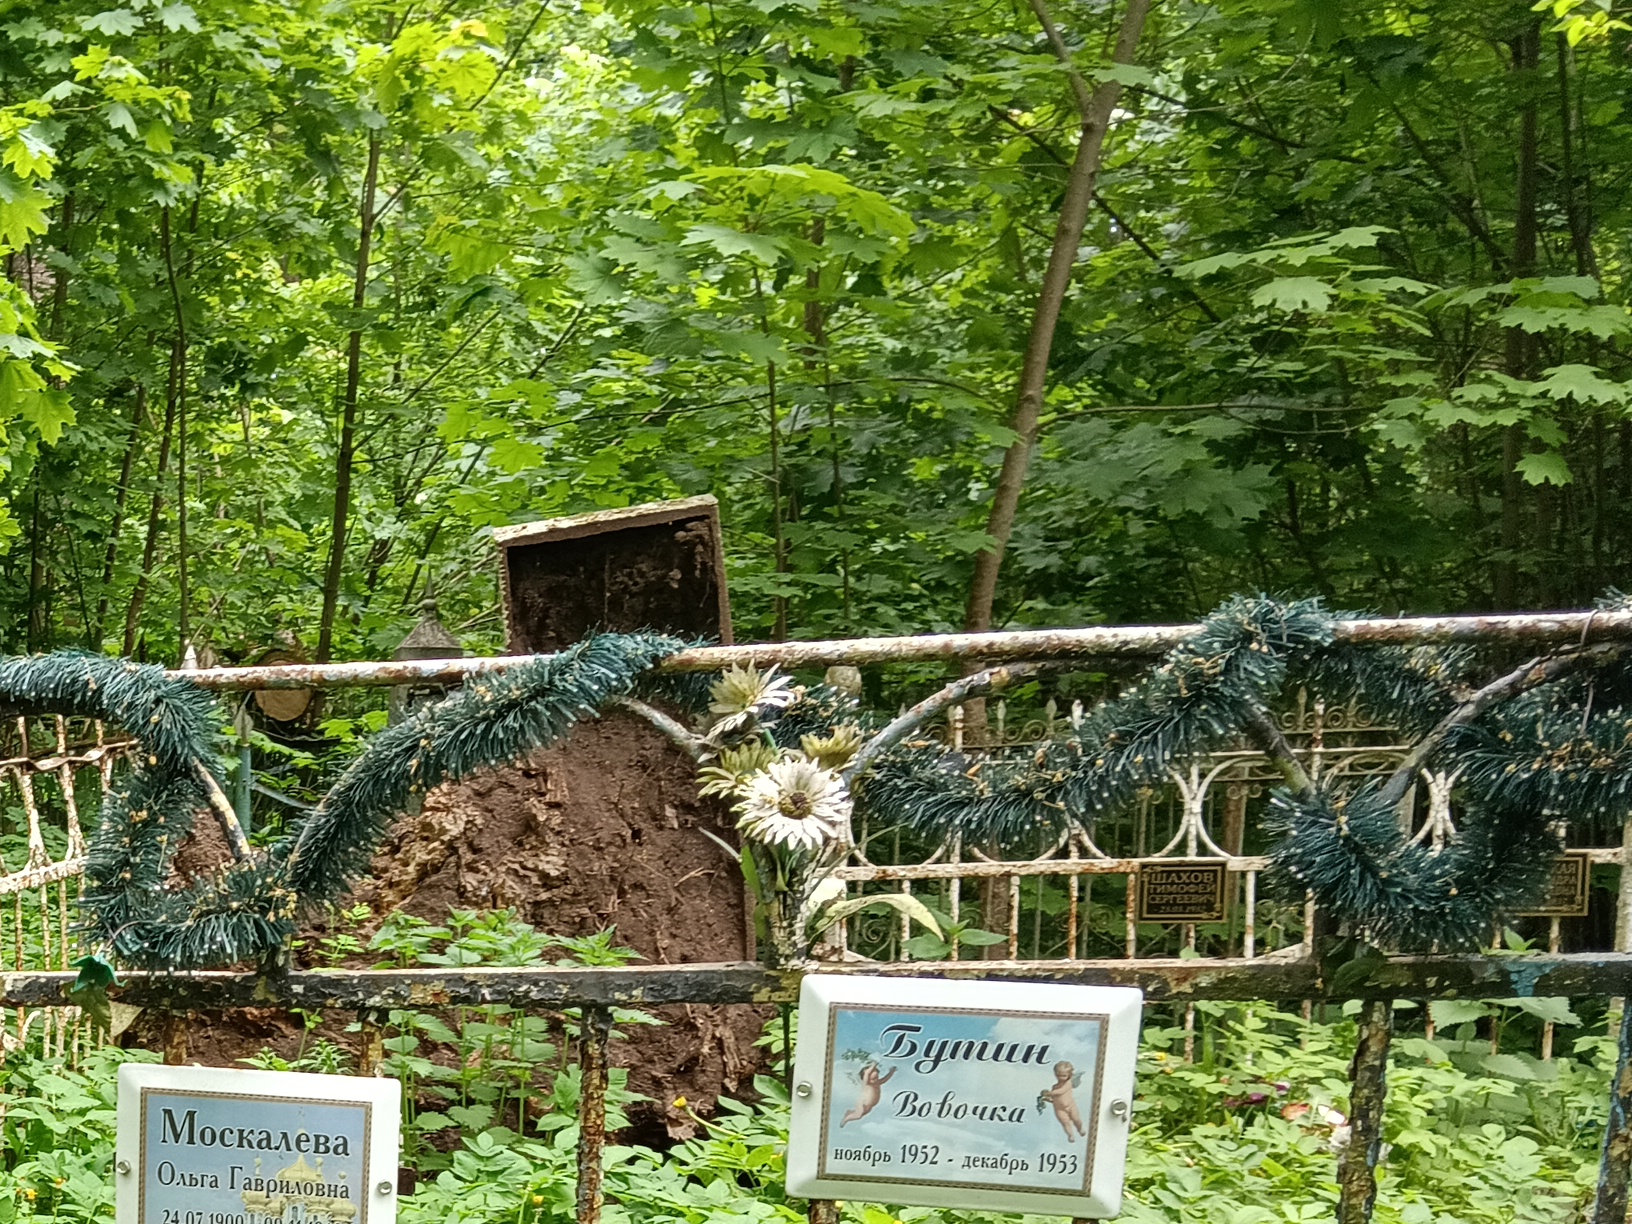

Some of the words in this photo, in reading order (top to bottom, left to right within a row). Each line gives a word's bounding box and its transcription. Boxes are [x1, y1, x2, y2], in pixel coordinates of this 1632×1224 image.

[1150, 872, 1214, 883] ШАХОВ
[880, 1024, 1051, 1074] Бутин
[892, 1090, 1027, 1123] Вовочка
[160, 1108, 350, 1157] Москалева
[833, 1145, 892, 1167] ноябрь
[900, 1144, 940, 1165] 1952
[961, 1153, 1029, 1175] декабрь
[1037, 1153, 1078, 1175] 1953
[157, 1161, 219, 1189] Ольга
[229, 1166, 350, 1199] Гавриловна
